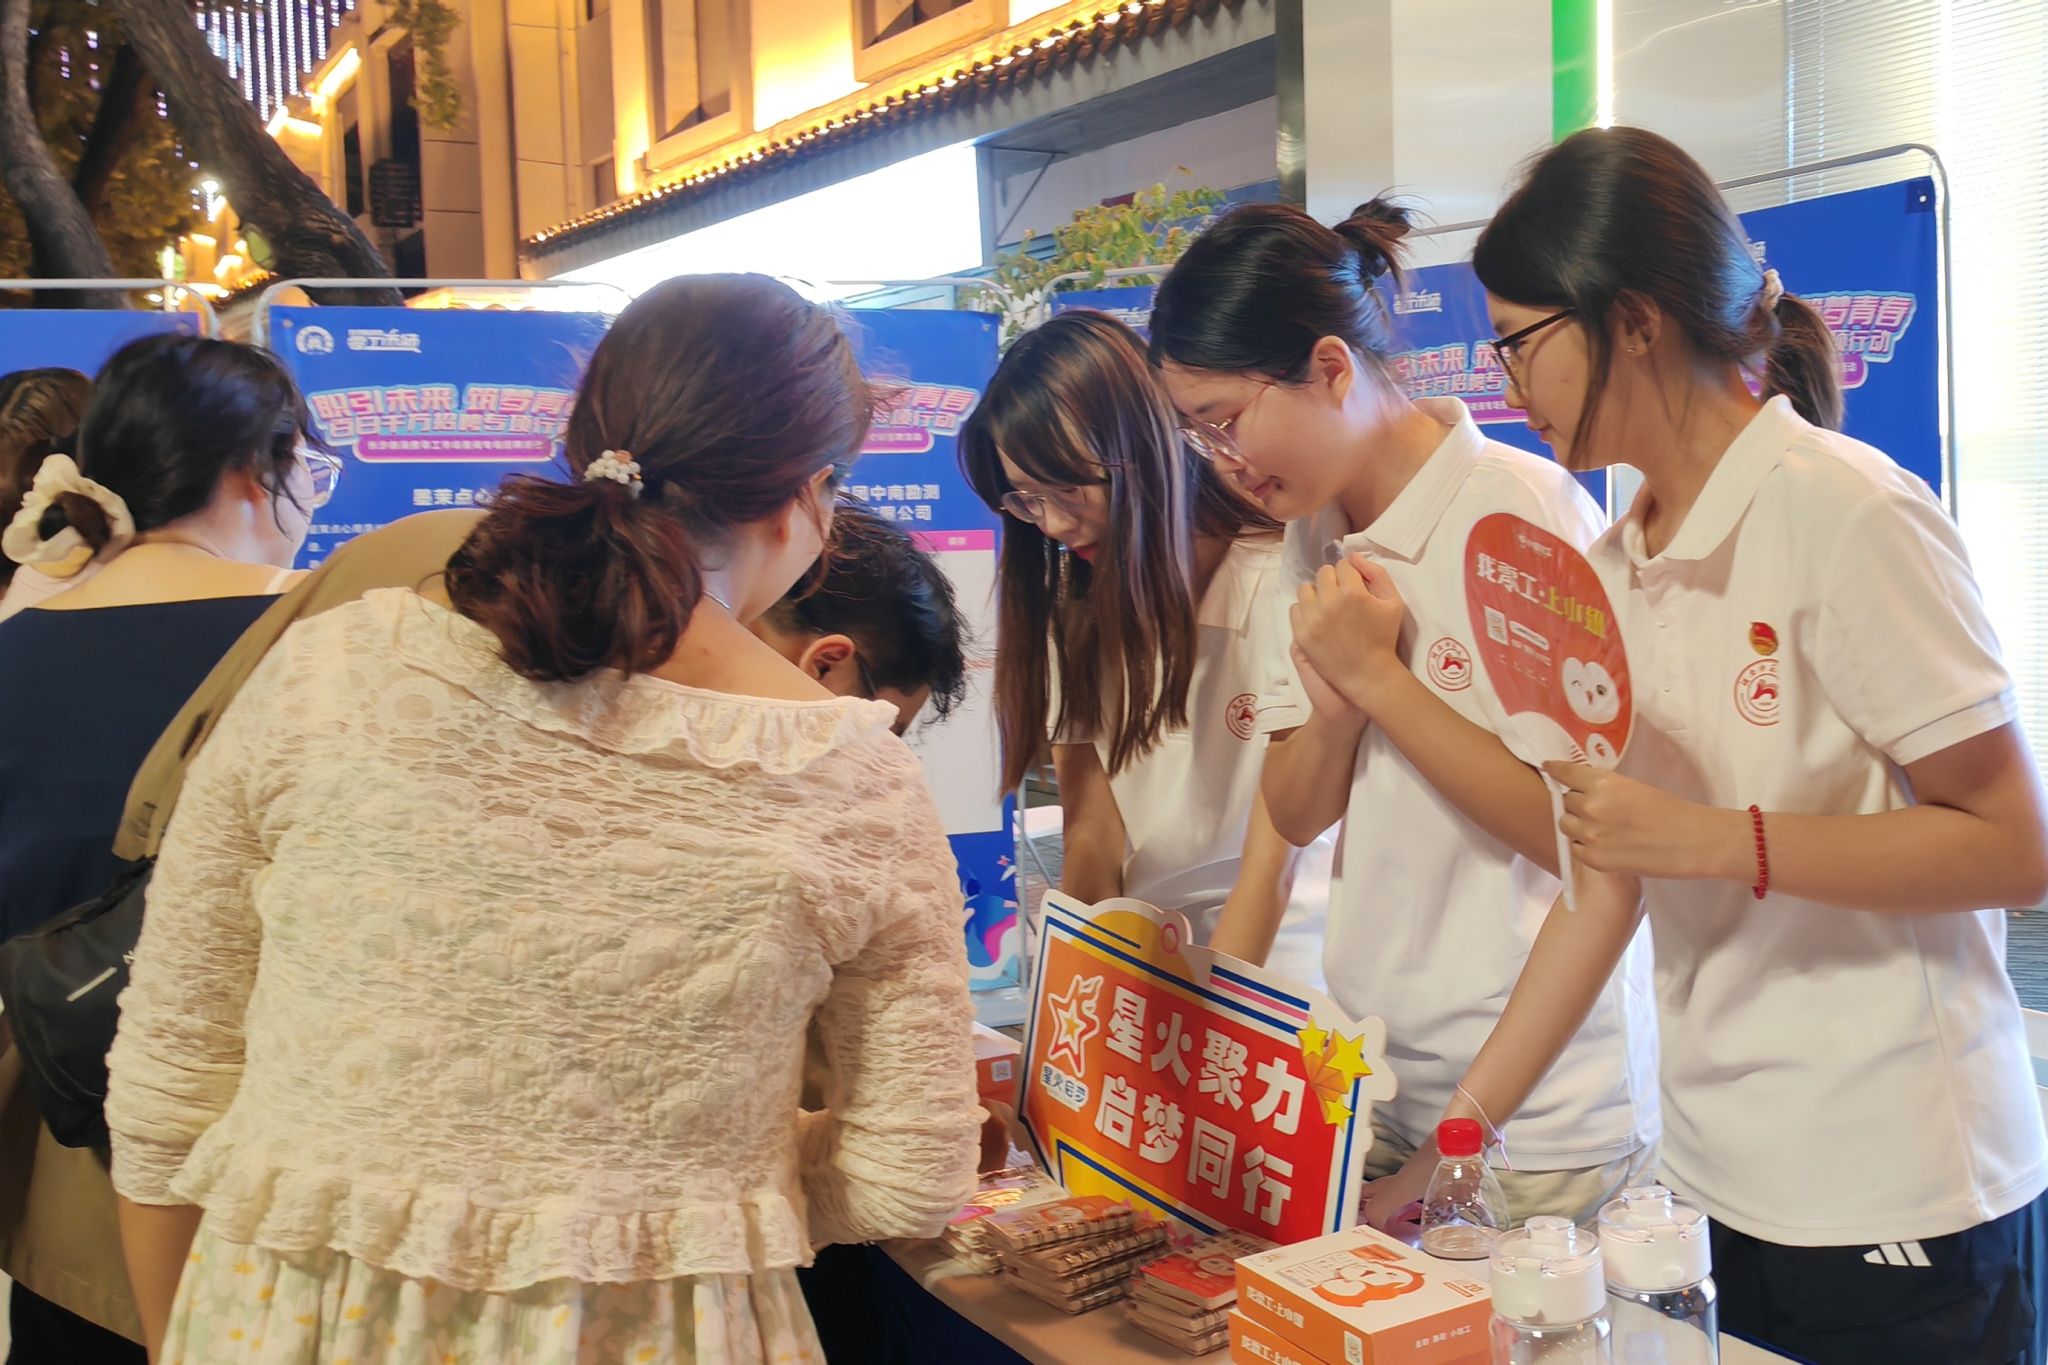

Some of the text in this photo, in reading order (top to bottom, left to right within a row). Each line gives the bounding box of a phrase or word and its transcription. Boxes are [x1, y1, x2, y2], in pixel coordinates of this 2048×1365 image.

[311, 387, 453, 419] 职引未来
[872, 505, 932, 521] 限公司
[1104, 985, 1306, 1136] 星火聚力
[1094, 1072, 1294, 1227] 启梦同行
